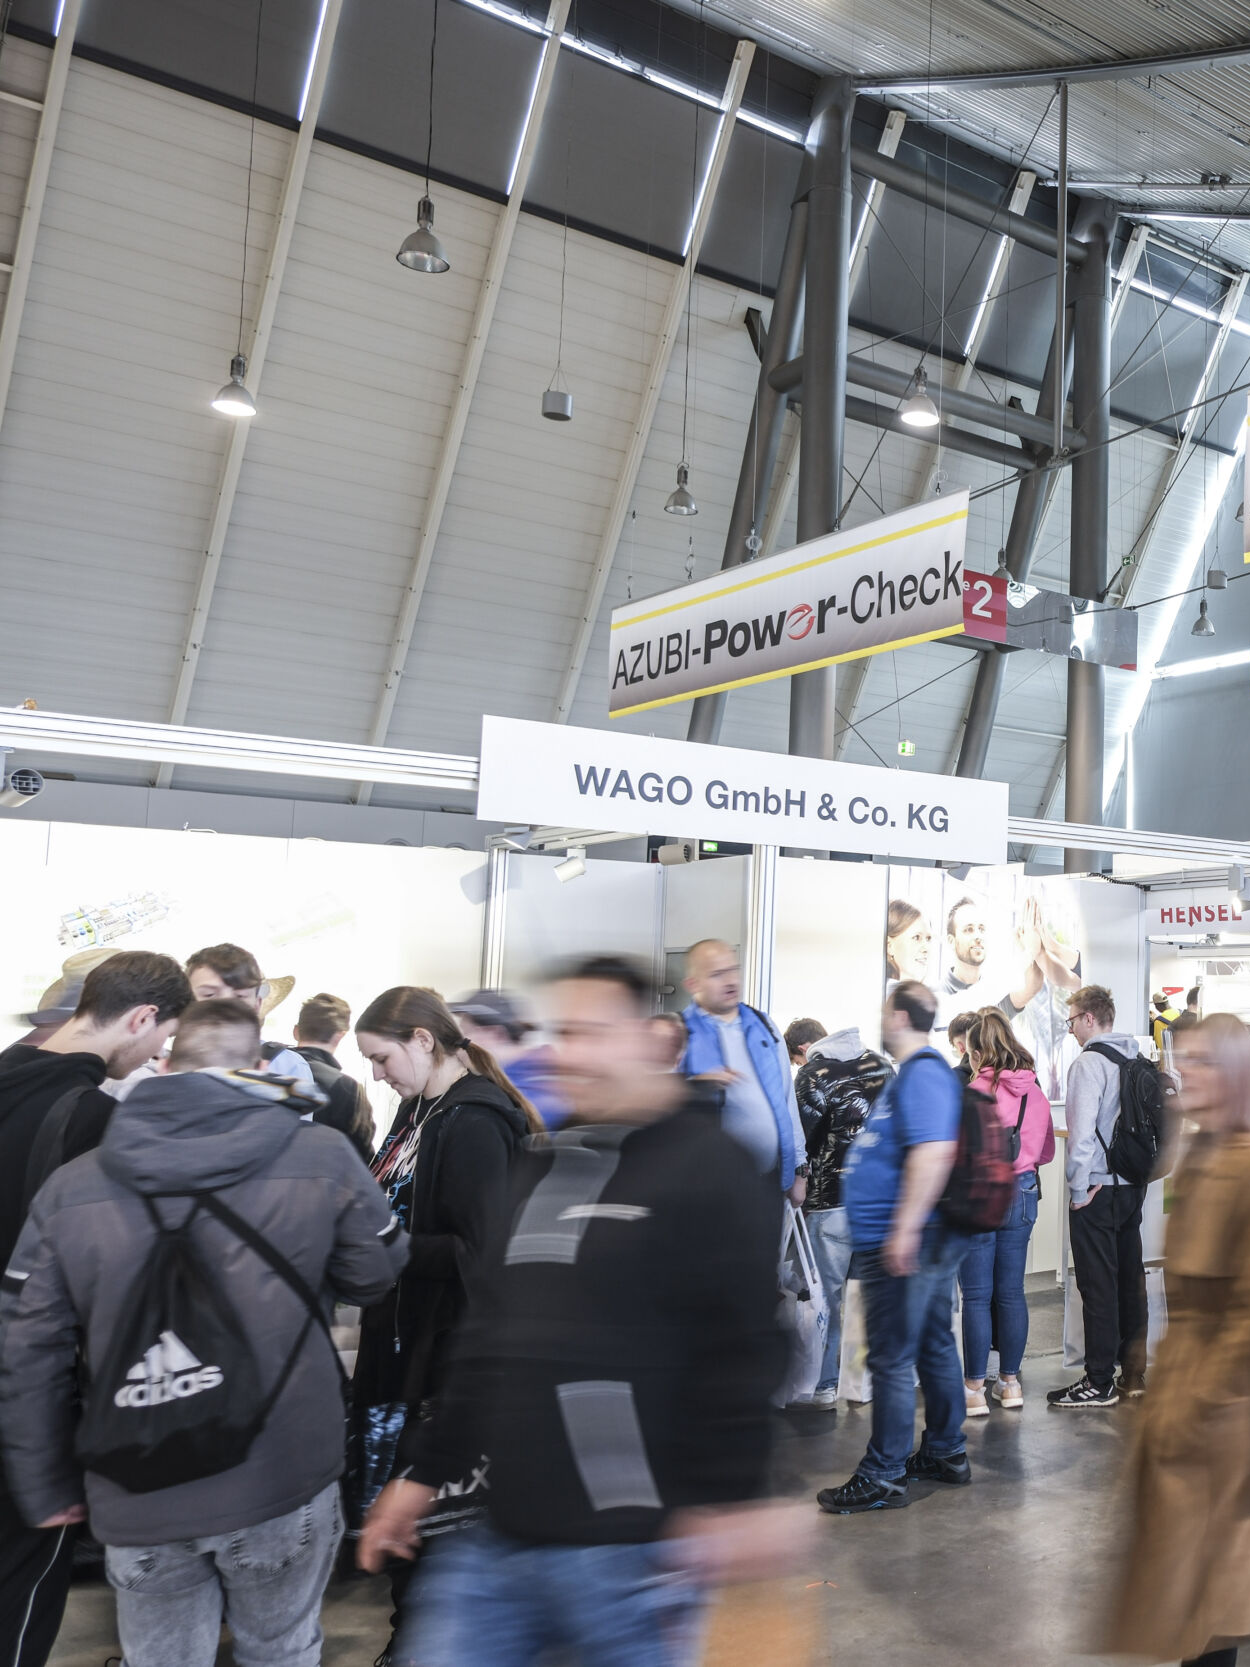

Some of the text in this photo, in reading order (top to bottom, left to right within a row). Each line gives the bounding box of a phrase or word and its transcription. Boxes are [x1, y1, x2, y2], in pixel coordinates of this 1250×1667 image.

[971, 580, 993, 619] 2
[573, 764, 949, 833] WAGO GmbH & Co. KG
[1160, 904, 1243, 927] HENSEL
